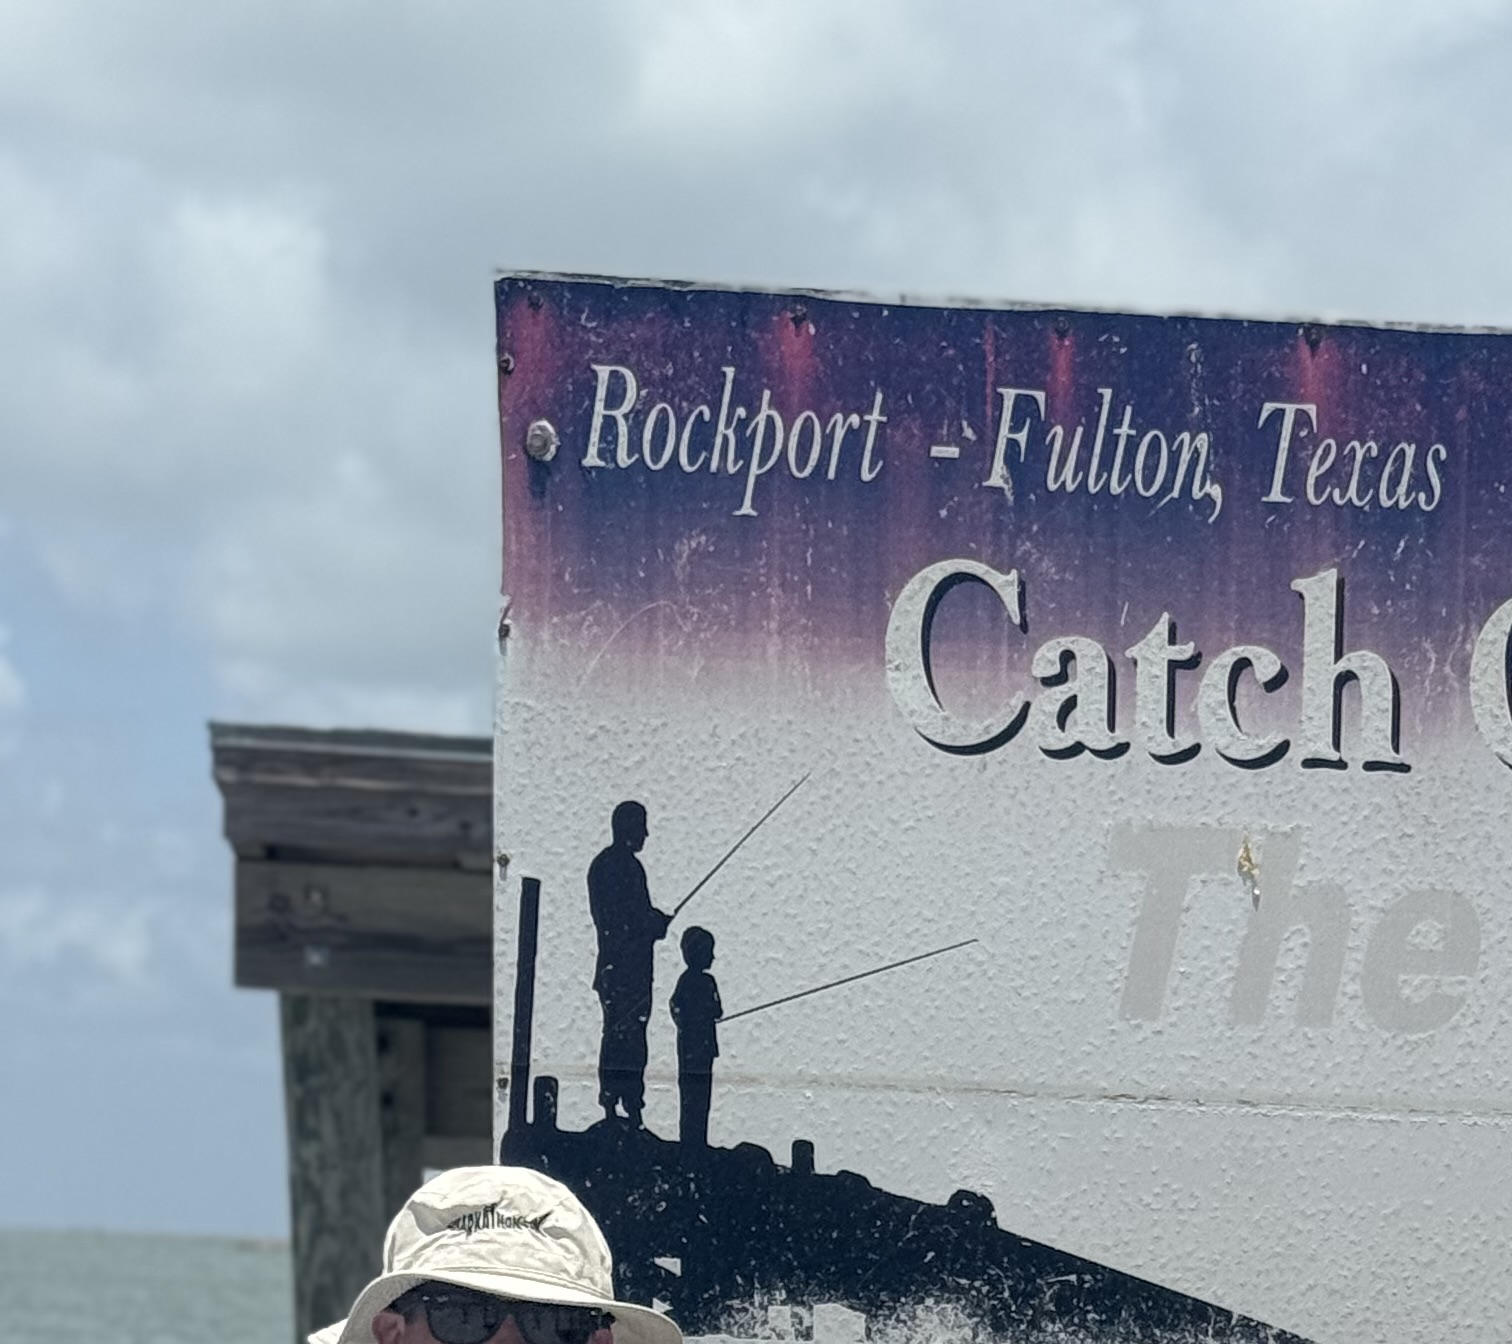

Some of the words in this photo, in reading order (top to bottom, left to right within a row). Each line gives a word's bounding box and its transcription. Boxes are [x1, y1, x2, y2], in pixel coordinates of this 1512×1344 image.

[582, 364, 888, 517] Rockport
[982, 387, 1223, 522] Fulton,
[1257, 399, 1447, 513] Texas
[885, 559, 1411, 772] Catch
[1109, 821, 1481, 1036] The
